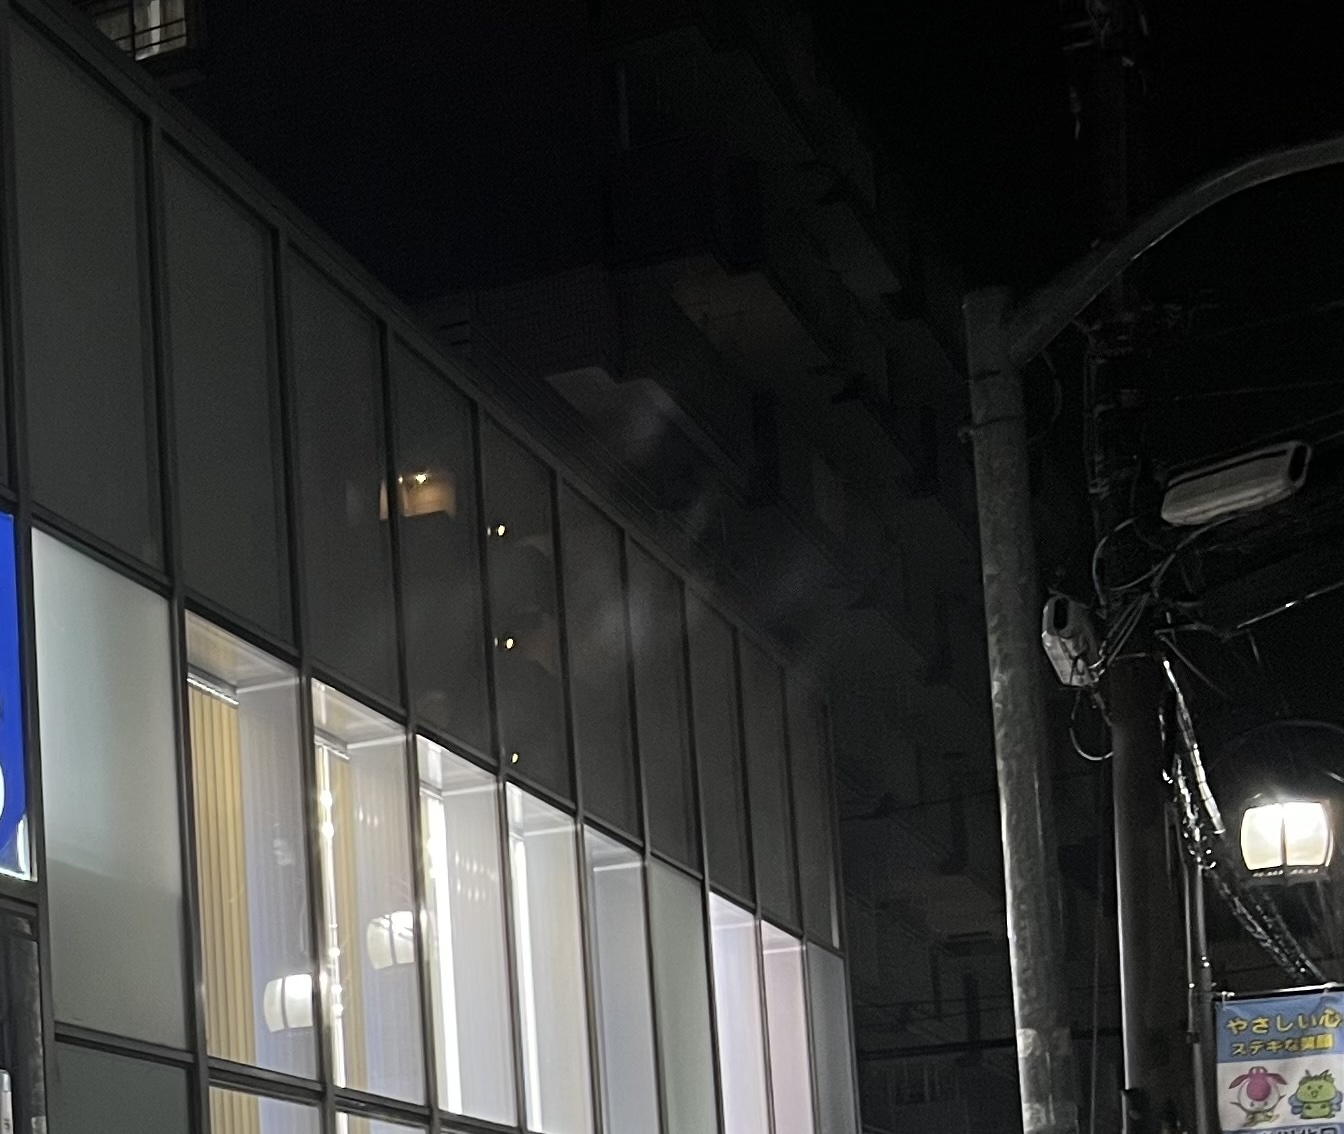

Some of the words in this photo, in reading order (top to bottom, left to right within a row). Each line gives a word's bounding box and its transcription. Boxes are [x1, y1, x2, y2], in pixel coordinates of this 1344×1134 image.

[1226, 1008, 1342, 1035] やさしい心
